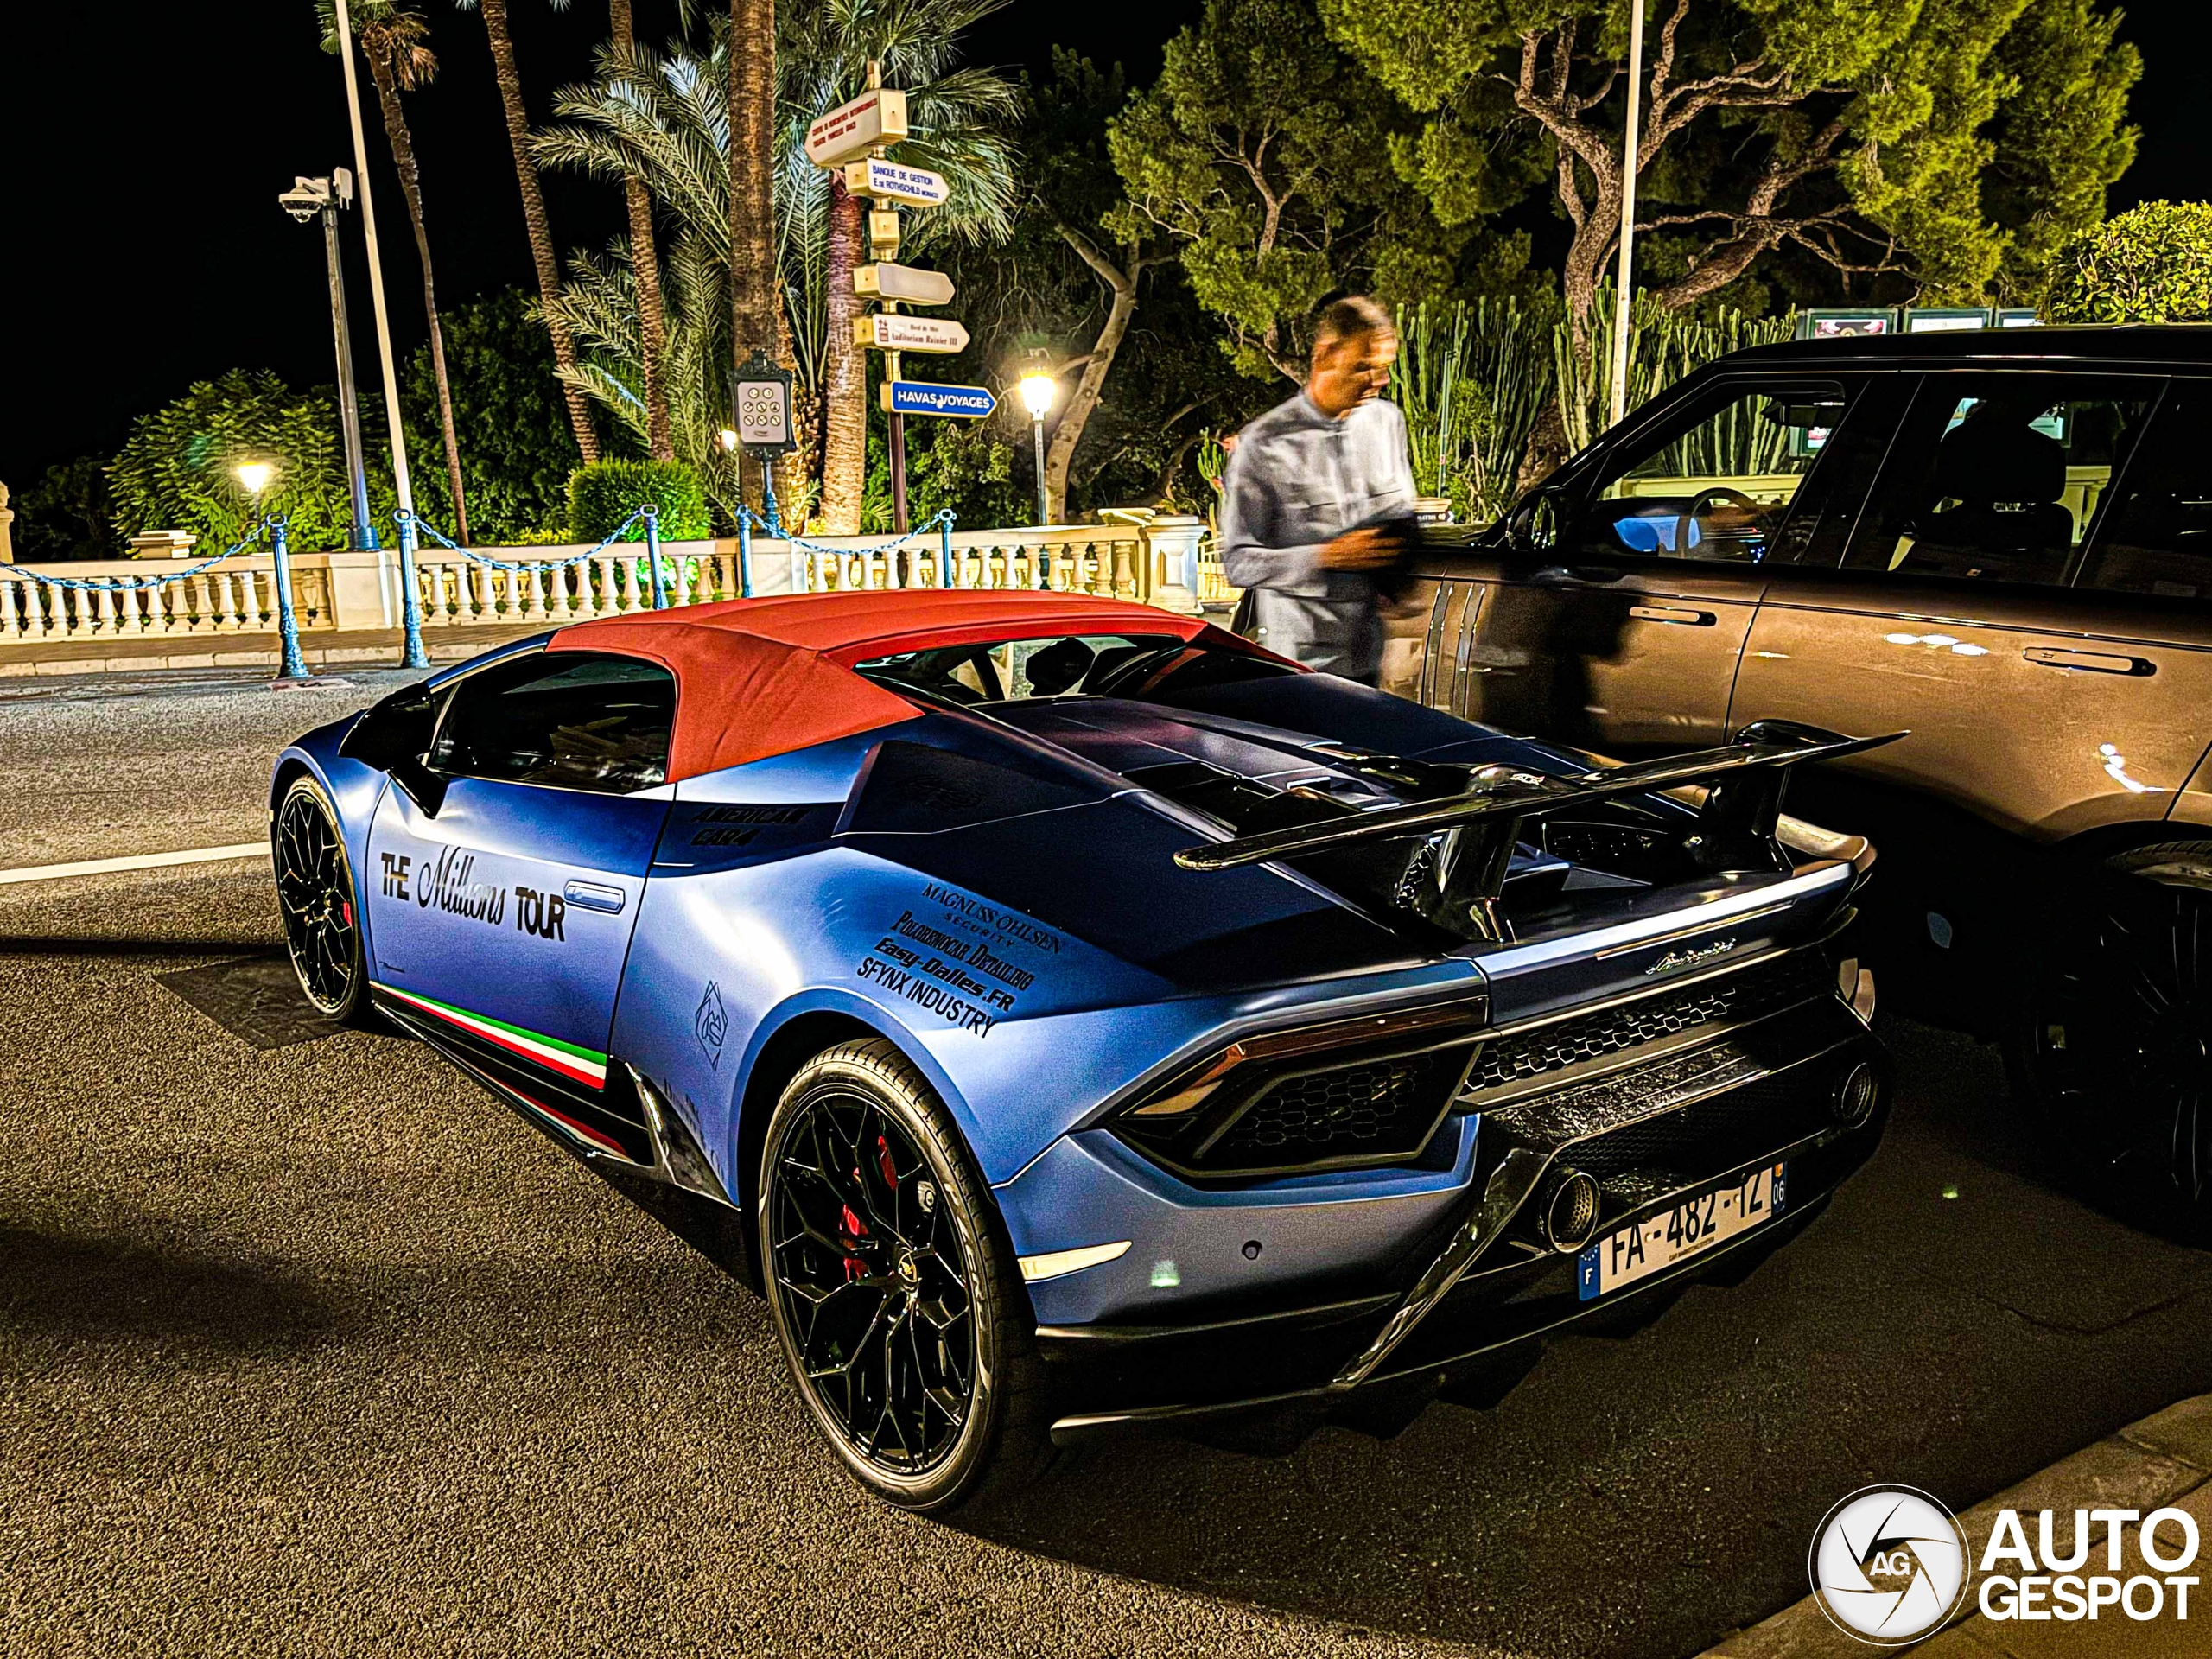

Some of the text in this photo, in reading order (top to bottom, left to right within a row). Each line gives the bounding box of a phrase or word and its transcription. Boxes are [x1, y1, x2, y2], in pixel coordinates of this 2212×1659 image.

[873, 165, 933, 186] BANQUE DE GESTION
[886, 180, 921, 195] ROTHSCHILD
[925, 335, 947, 345] Rainier
[949, 337, 957, 346] III
[898, 391, 990, 409] HAVAS VOYAGES
[381, 844, 565, 942] THE Millions TOUR
[922, 882, 1062, 954] MAGNUSS OHLSEN
[944, 912, 1014, 947] SECURITY
[857, 957, 998, 1039] SFYNX INDUSTRY
[1773, 1180, 1784, 1205] 06
[1585, 1268, 1593, 1285] F
